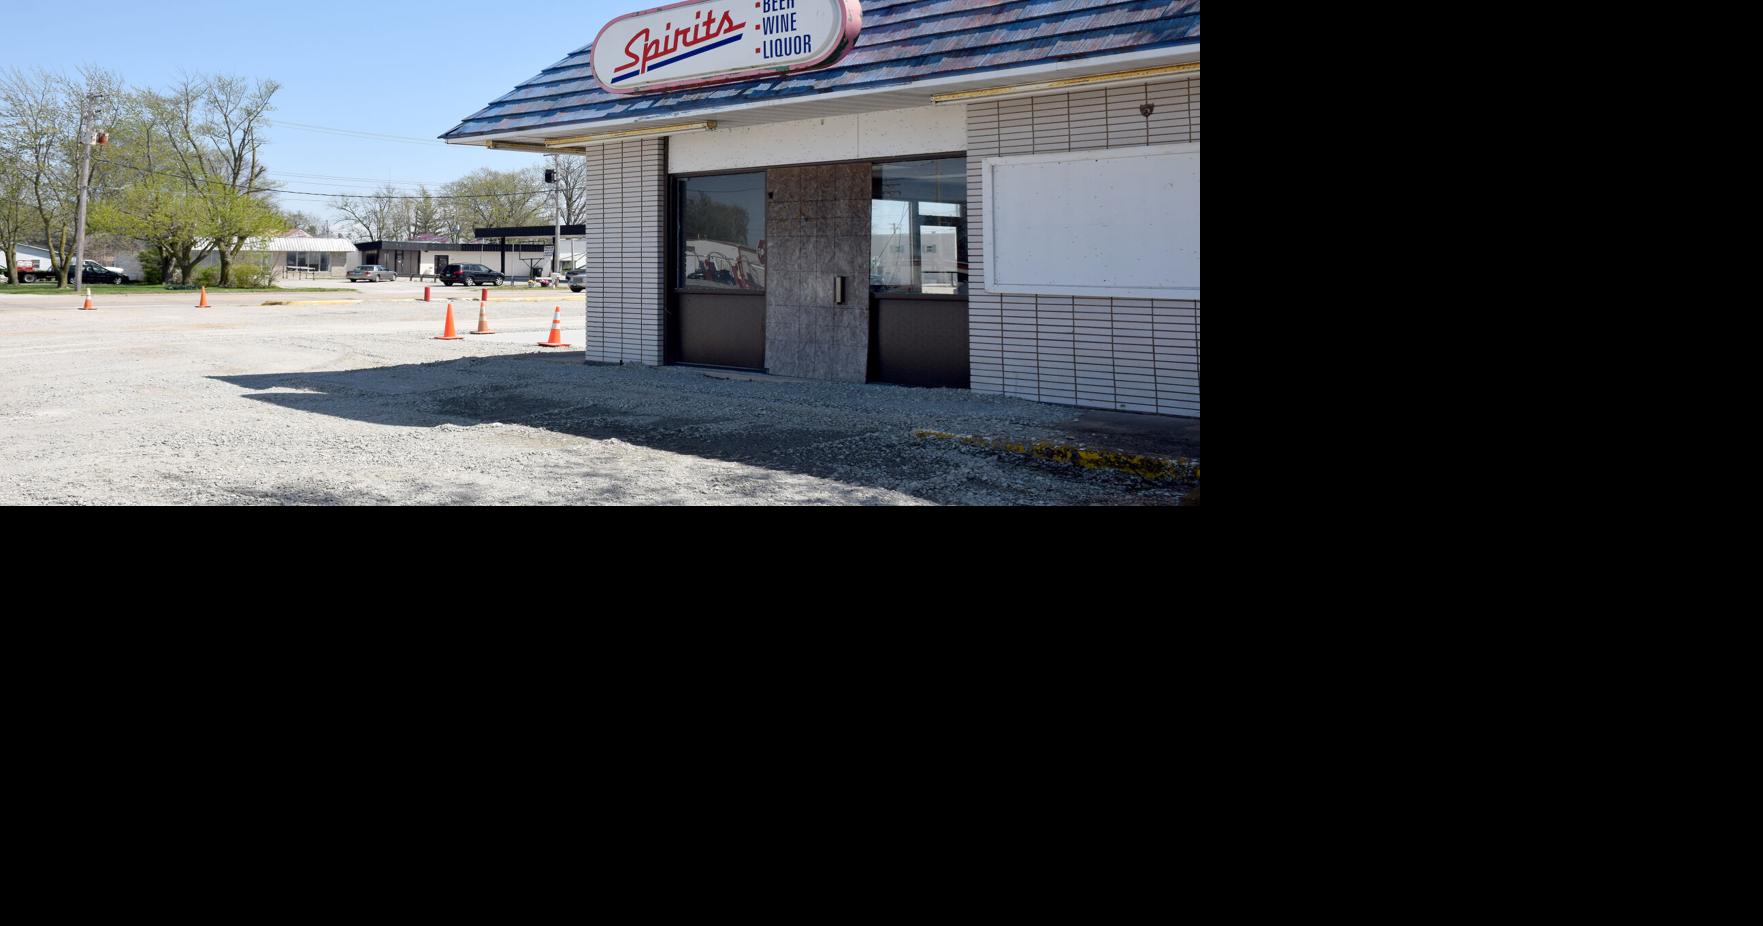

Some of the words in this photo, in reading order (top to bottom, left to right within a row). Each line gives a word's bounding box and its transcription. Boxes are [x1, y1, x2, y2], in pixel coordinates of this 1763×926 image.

[762, 12, 797, 35] WINE
[613, 10, 746, 74] Spirits
[763, 34, 812, 59] LIQUOR
